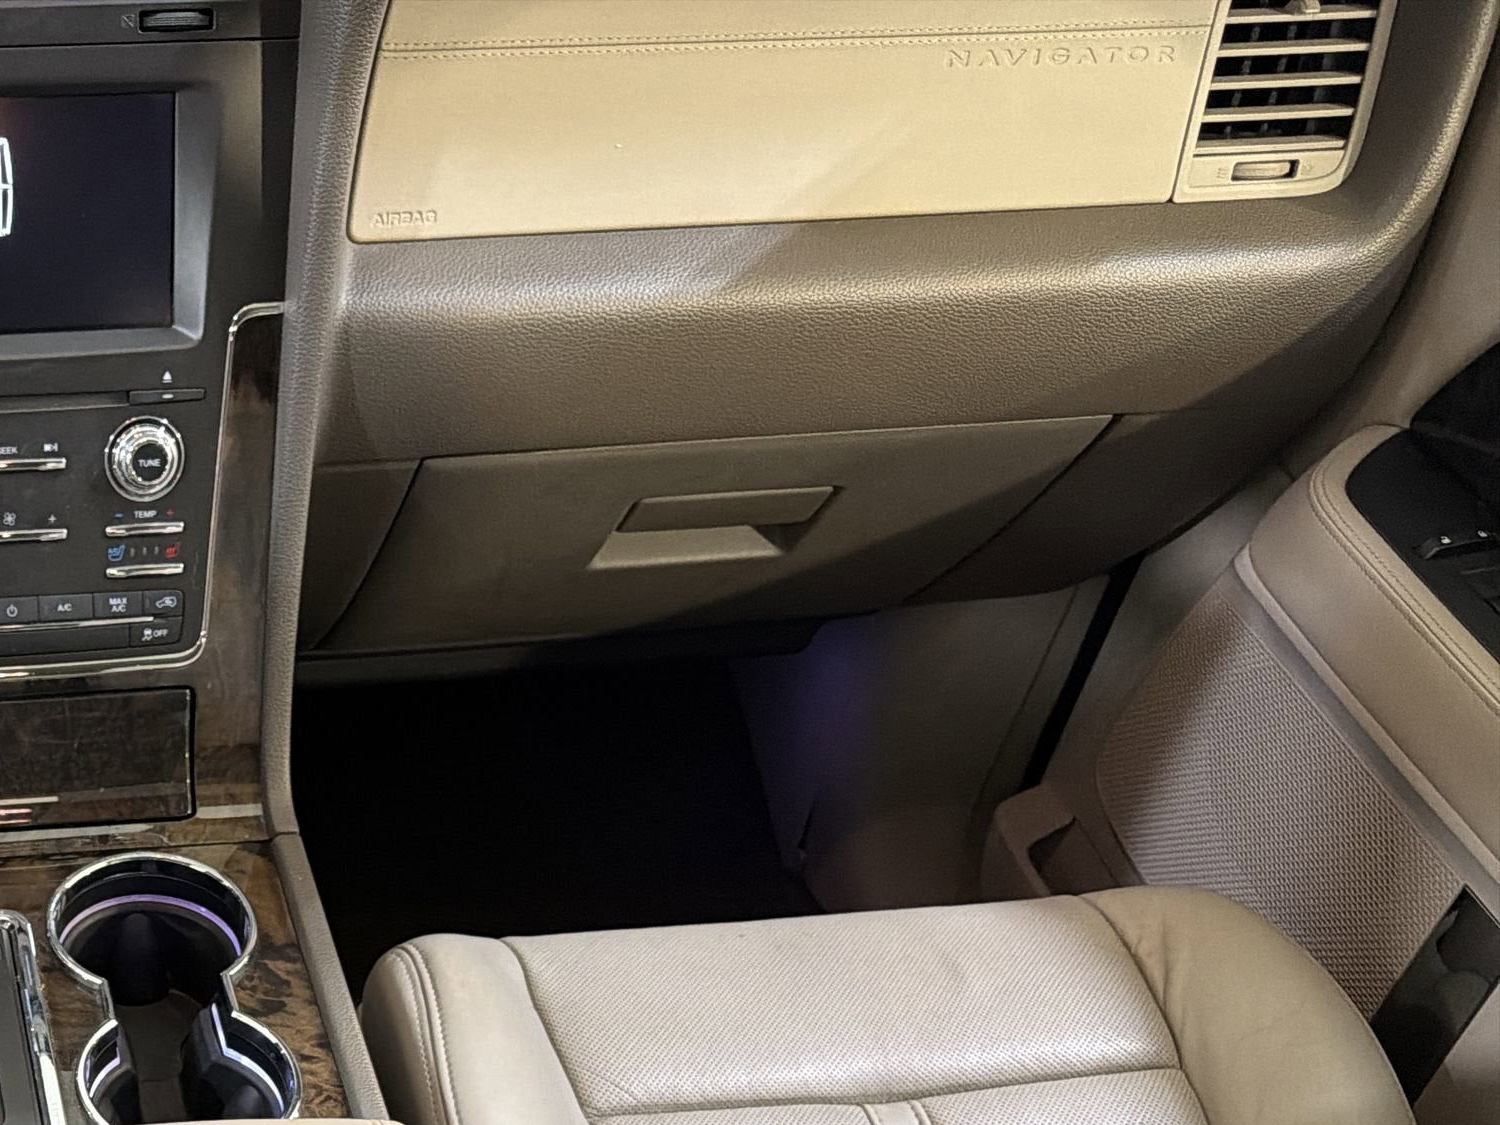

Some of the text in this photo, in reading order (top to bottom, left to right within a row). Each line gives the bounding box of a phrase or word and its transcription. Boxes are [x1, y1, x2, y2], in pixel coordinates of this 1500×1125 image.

[947, 44, 1176, 68] NAVIGATOR
[370, 208, 438, 227] AIRBAG
[138, 458, 161, 468] TUNE
[133, 510, 158, 519] TEMP
[108, 597, 128, 605] MAX
[57, 603, 73, 612] A/C
[111, 605, 127, 613] A/C
[153, 629, 169, 637] OFF
